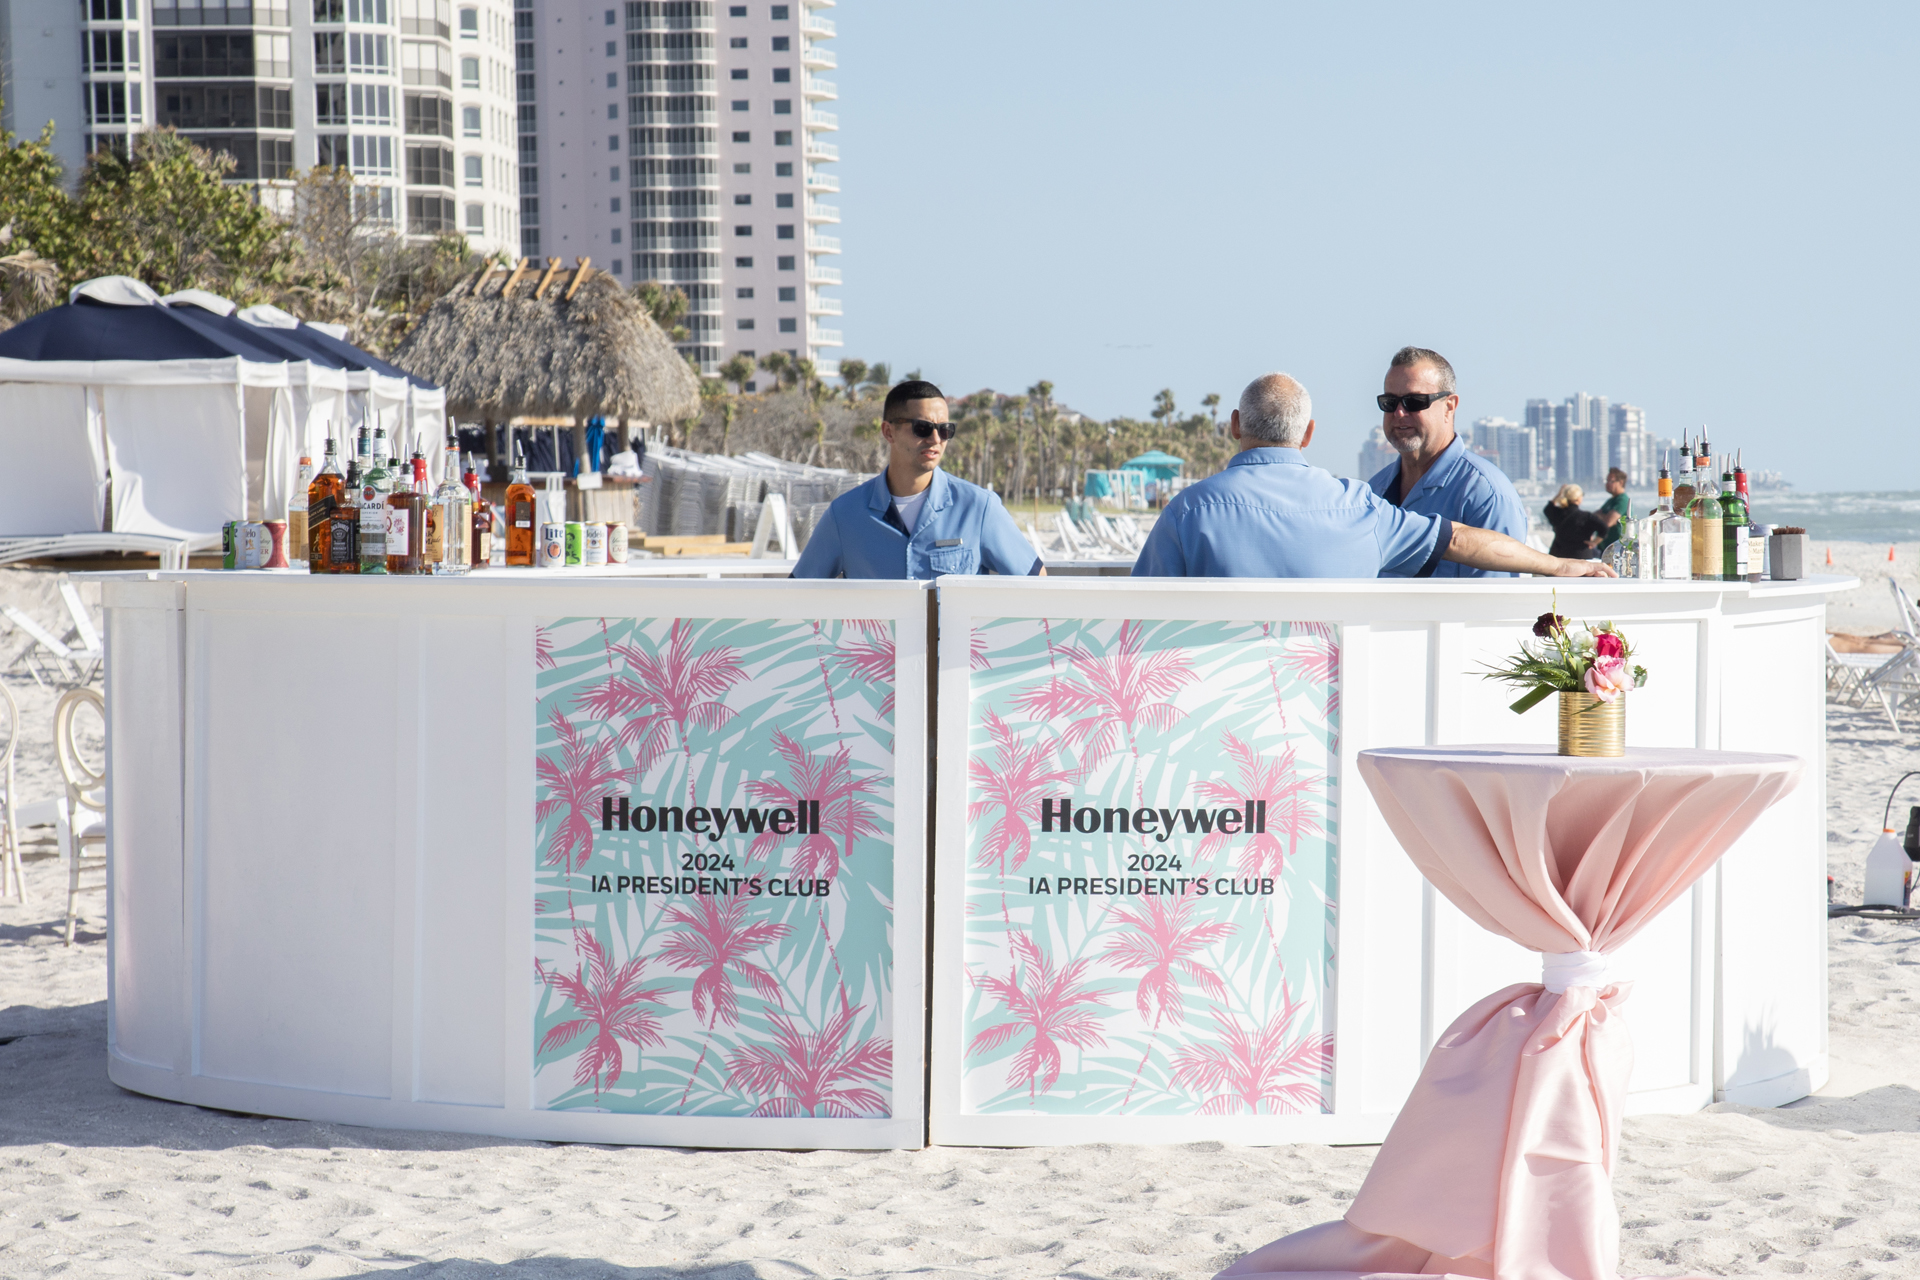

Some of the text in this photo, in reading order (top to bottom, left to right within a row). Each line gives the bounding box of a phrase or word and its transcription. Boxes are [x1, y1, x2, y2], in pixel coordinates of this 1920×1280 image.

[545, 528, 563, 541] Lite
[602, 797, 820, 843] Honeywell
[1041, 799, 1266, 843] Honeywell
[682, 854, 735, 872] 2024
[1127, 854, 1182, 872] 2024
[592, 875, 830, 897] IA PRESIDENT’S CLUB
[1029, 877, 1274, 896] IA PRESIDENT’S CLUB
